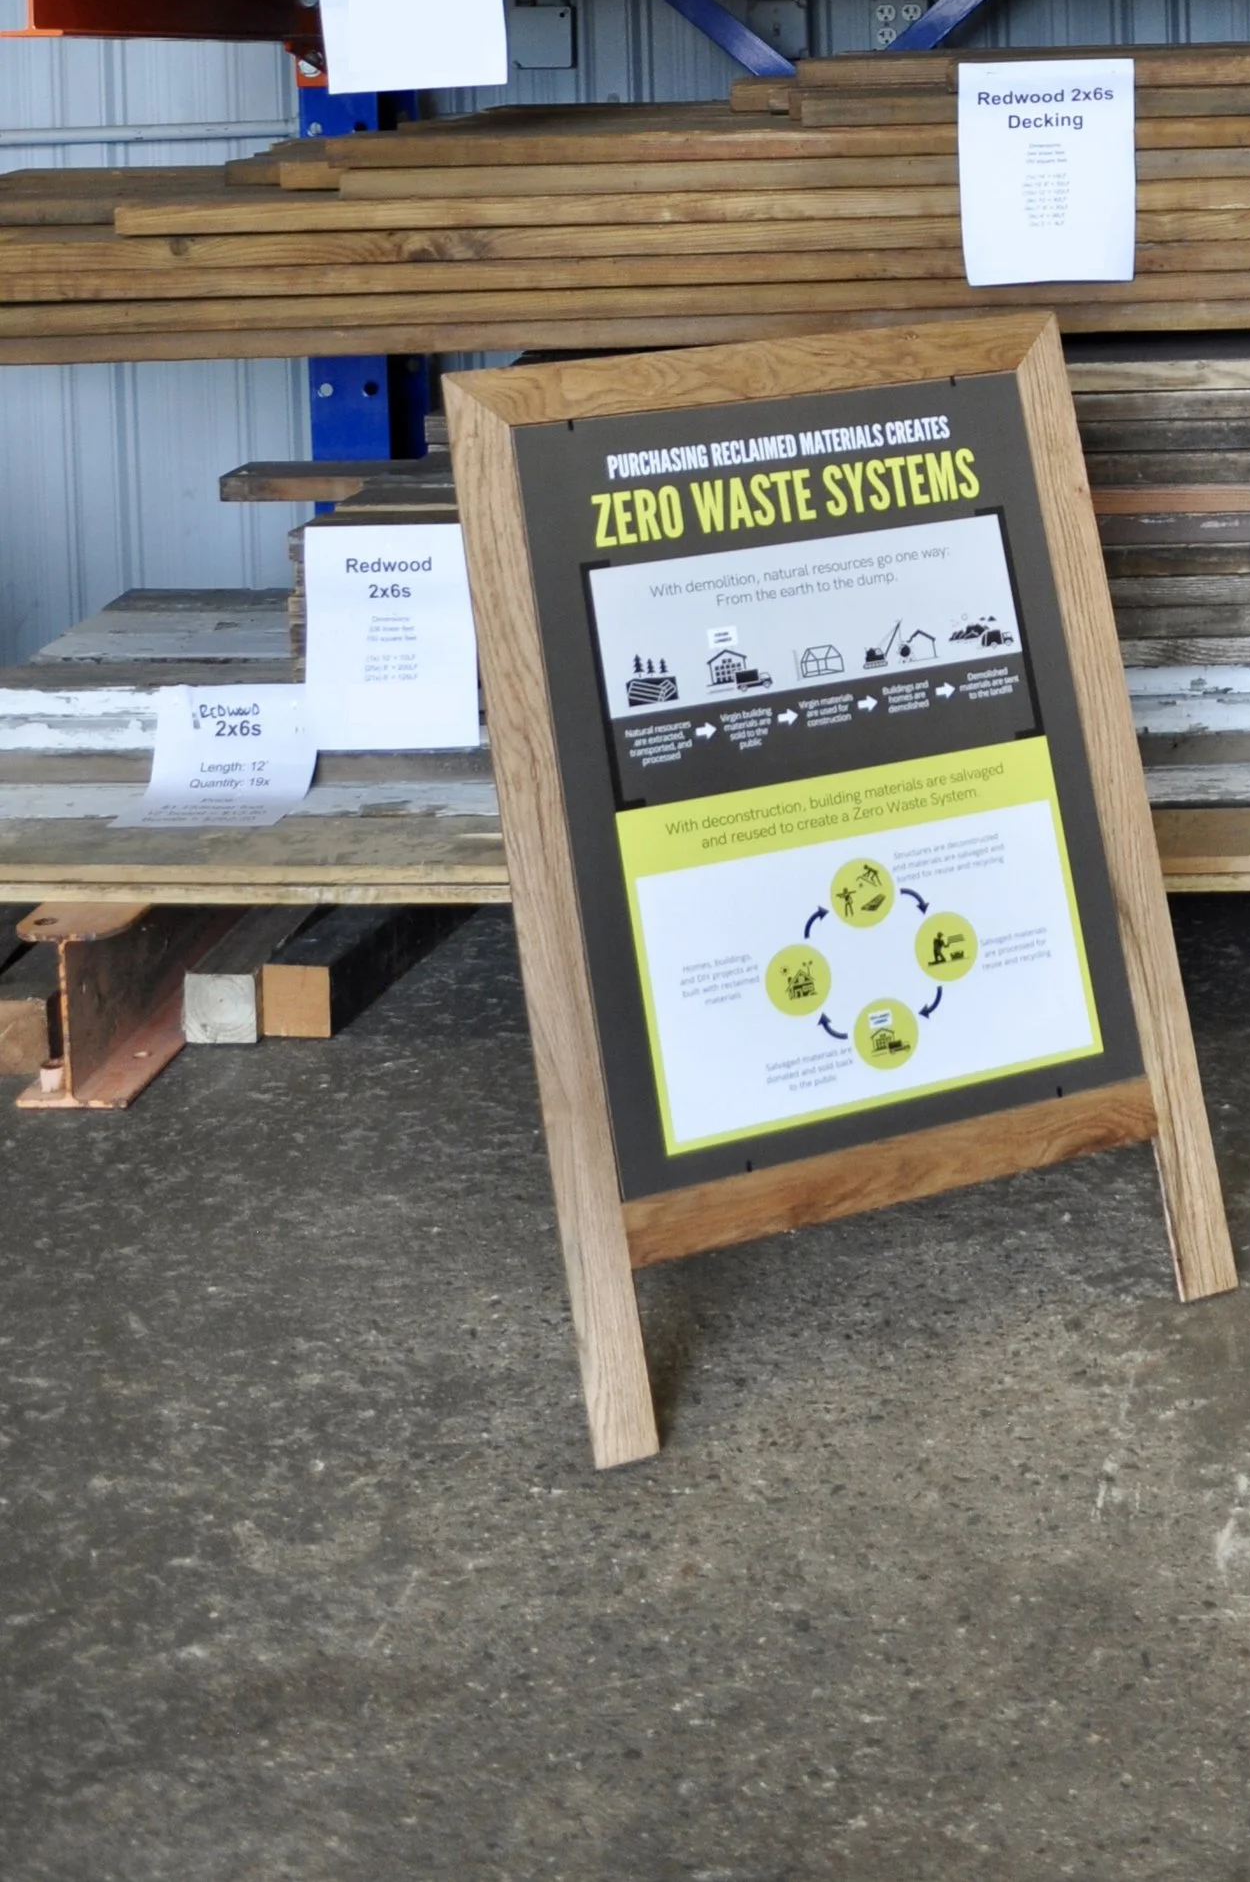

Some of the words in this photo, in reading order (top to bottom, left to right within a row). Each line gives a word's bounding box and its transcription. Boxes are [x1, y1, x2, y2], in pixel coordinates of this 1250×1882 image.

[977, 89, 1065, 106] Redwood
[1071, 87, 1114, 102] 2x6s
[1008, 113, 1084, 130] Decking
[606, 444, 709, 480] PURCHASING
[710, 433, 798, 467] RECLAIMED
[799, 422, 885, 456] MATERIALS
[884, 415, 950, 446] CREATES
[591, 484, 685, 548] ZERO
[690, 468, 817, 534] WASTE
[822, 447, 980, 517] SYSTEMS
[345, 556, 432, 574] Redwood
[649, 584, 682, 598] With
[685, 573, 760, 594] demolition,
[763, 564, 809, 582] natural
[812, 557, 874, 575] resources
[877, 554, 893, 569] go
[895, 550, 919, 563] one
[921, 546, 950, 559] way:
[368, 583, 412, 598] 2x6s
[716, 592, 753, 607] From
[756, 589, 777, 602] the
[780, 582, 814, 598] earth
[817, 581, 831, 593] to
[833, 578, 854, 590] the
[857, 571, 898, 587] dump.
[882, 683, 914, 696] Buildings
[915, 679, 929, 689] and
[798, 698, 819, 710] Virgin
[806, 709, 819, 718] are
[820, 705, 837, 716] used
[720, 711, 742, 723] Virgin
[742, 707, 773, 718] building
[807, 713, 852, 728] construction
[215, 720, 262, 737] 2x6s
[625, 726, 653, 738] Natural
[654, 721, 691, 733] resources
[724, 720, 758, 732] materials
[759, 717, 771, 726] are
[634, 737, 647, 747] are
[730, 731, 746, 741] sold
[756, 727, 768, 736] the
[677, 738, 692, 749] and
[739, 738, 762, 751] public
[642, 751, 681, 767] processed
[200, 762, 245, 774] Length:
[190, 778, 243, 789] Quantity:
[250, 777, 271, 787] 19x
[665, 820, 698, 835] With
[702, 802, 806, 829] deconstruction,
[810, 790, 862, 809] building
[864, 778, 924, 799] materials
[926, 774, 947, 788] are
[950, 762, 1004, 784] salvaged
[702, 834, 727, 849] and
[731, 824, 776, 843] reused
[780, 821, 793, 834] to
[797, 812, 838, 831] create
[842, 813, 850, 822] a
[853, 805, 884, 821] Zero
[887, 796, 928, 814] Waste
